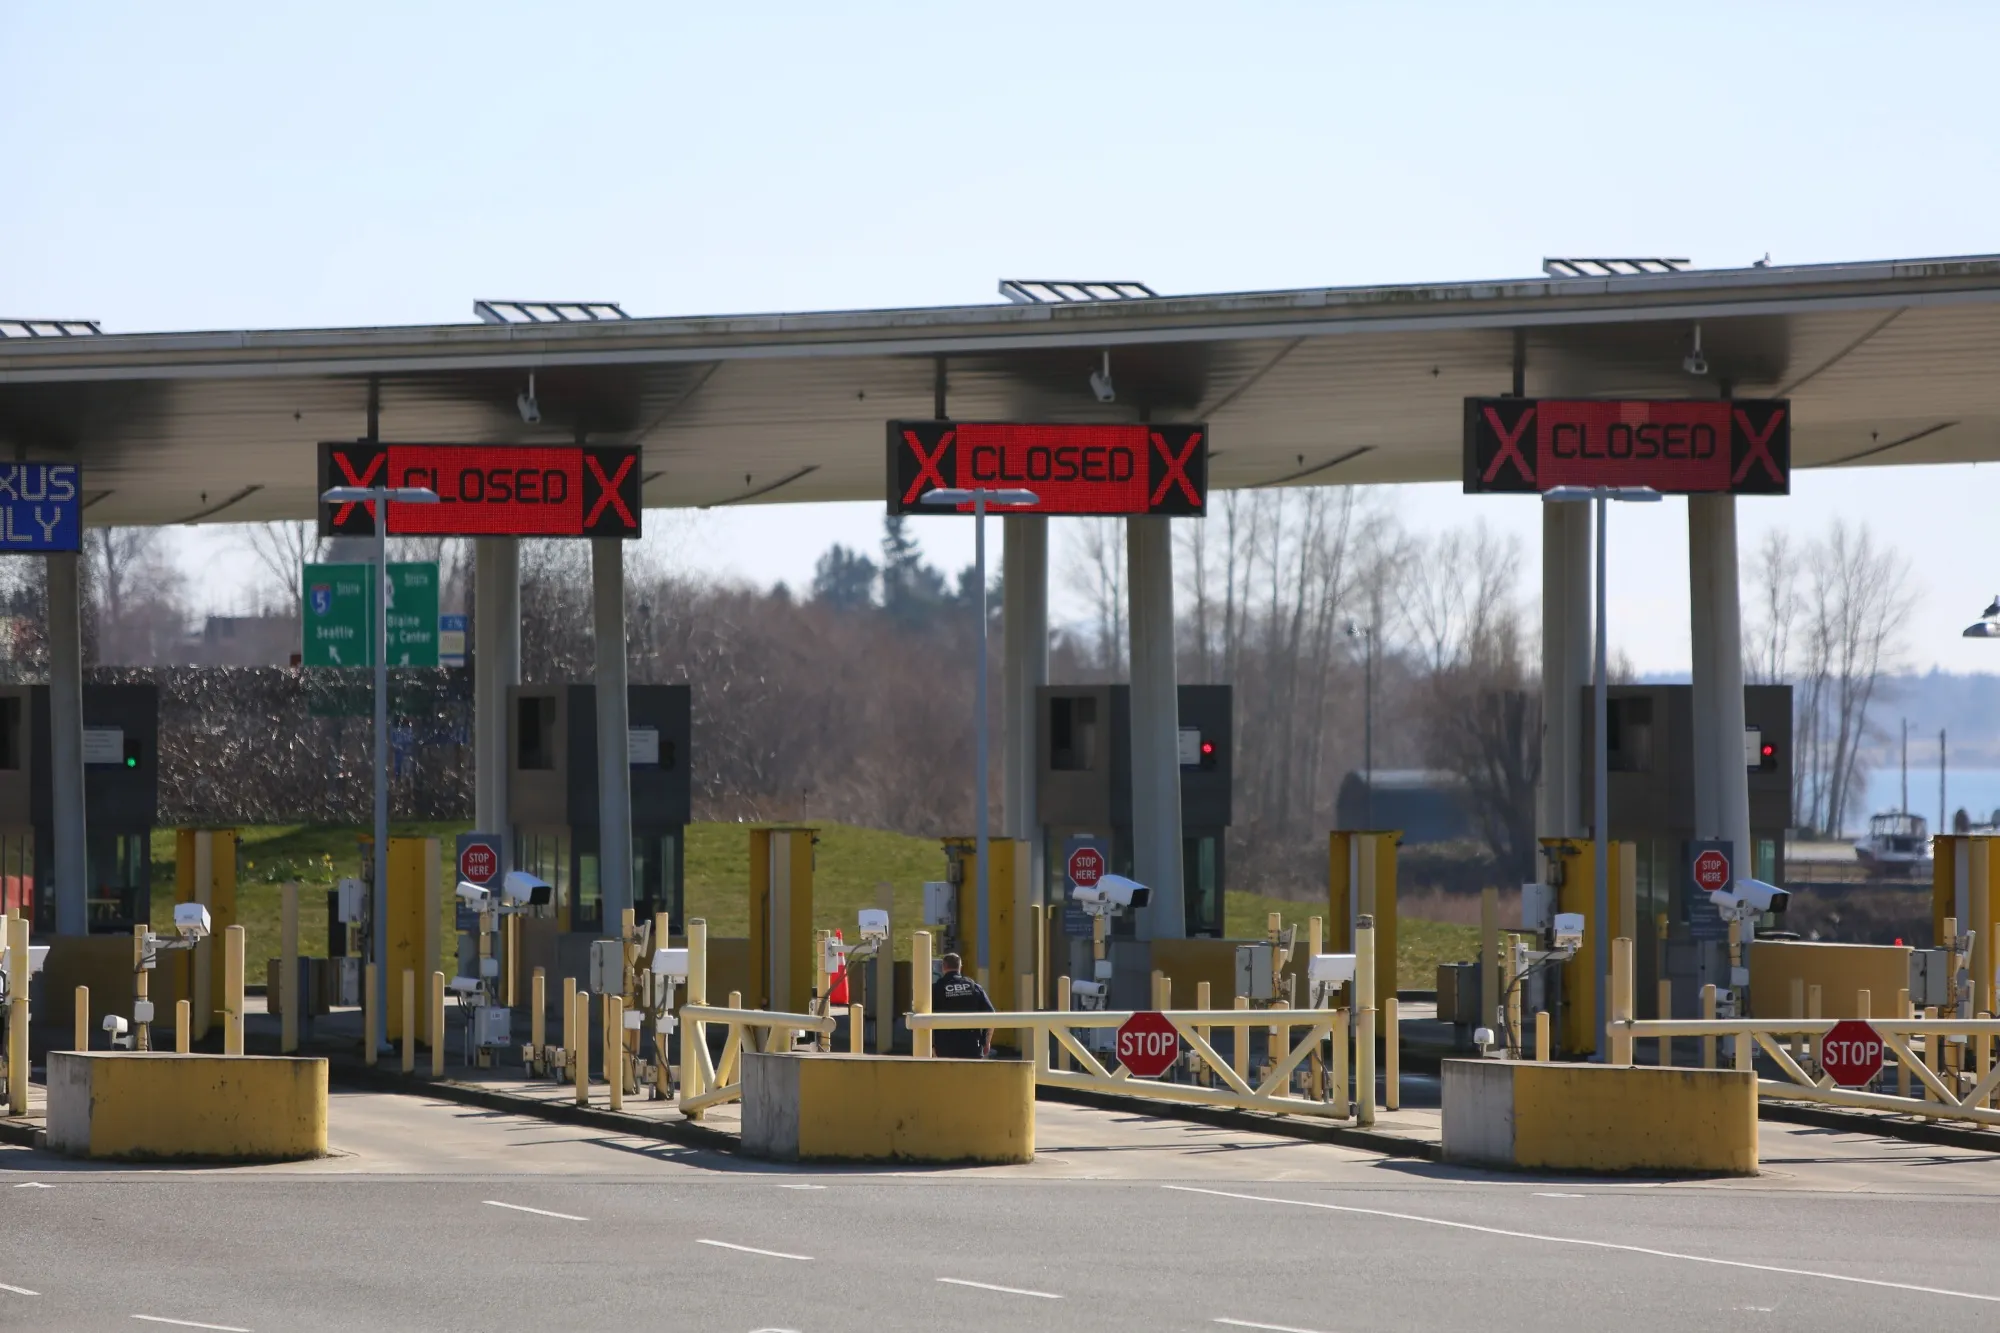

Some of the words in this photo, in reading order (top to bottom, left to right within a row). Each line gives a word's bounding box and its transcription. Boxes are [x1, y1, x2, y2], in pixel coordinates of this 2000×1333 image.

[1552, 423, 1716, 459] CLOSED
[971, 446, 1134, 482] CLOSED
[403, 467, 568, 504] CLOSED
[0, 506, 61, 541] LY
[316, 591, 326, 614] 5
[387, 613, 420, 628] Blaine
[316, 625, 354, 640] Seattle
[399, 629, 432, 644] Center
[468, 853, 490, 863] STOP
[1076, 857, 1097, 867] STOP
[1702, 860, 1722, 870] STOP
[468, 865, 490, 875] HERE
[1075, 870, 1097, 880] HERE
[1702, 872, 1722, 882] HERE
[945, 983, 971, 992] CBP
[1120, 1032, 1175, 1056] STOP
[1825, 1041, 1880, 1066] STOP
